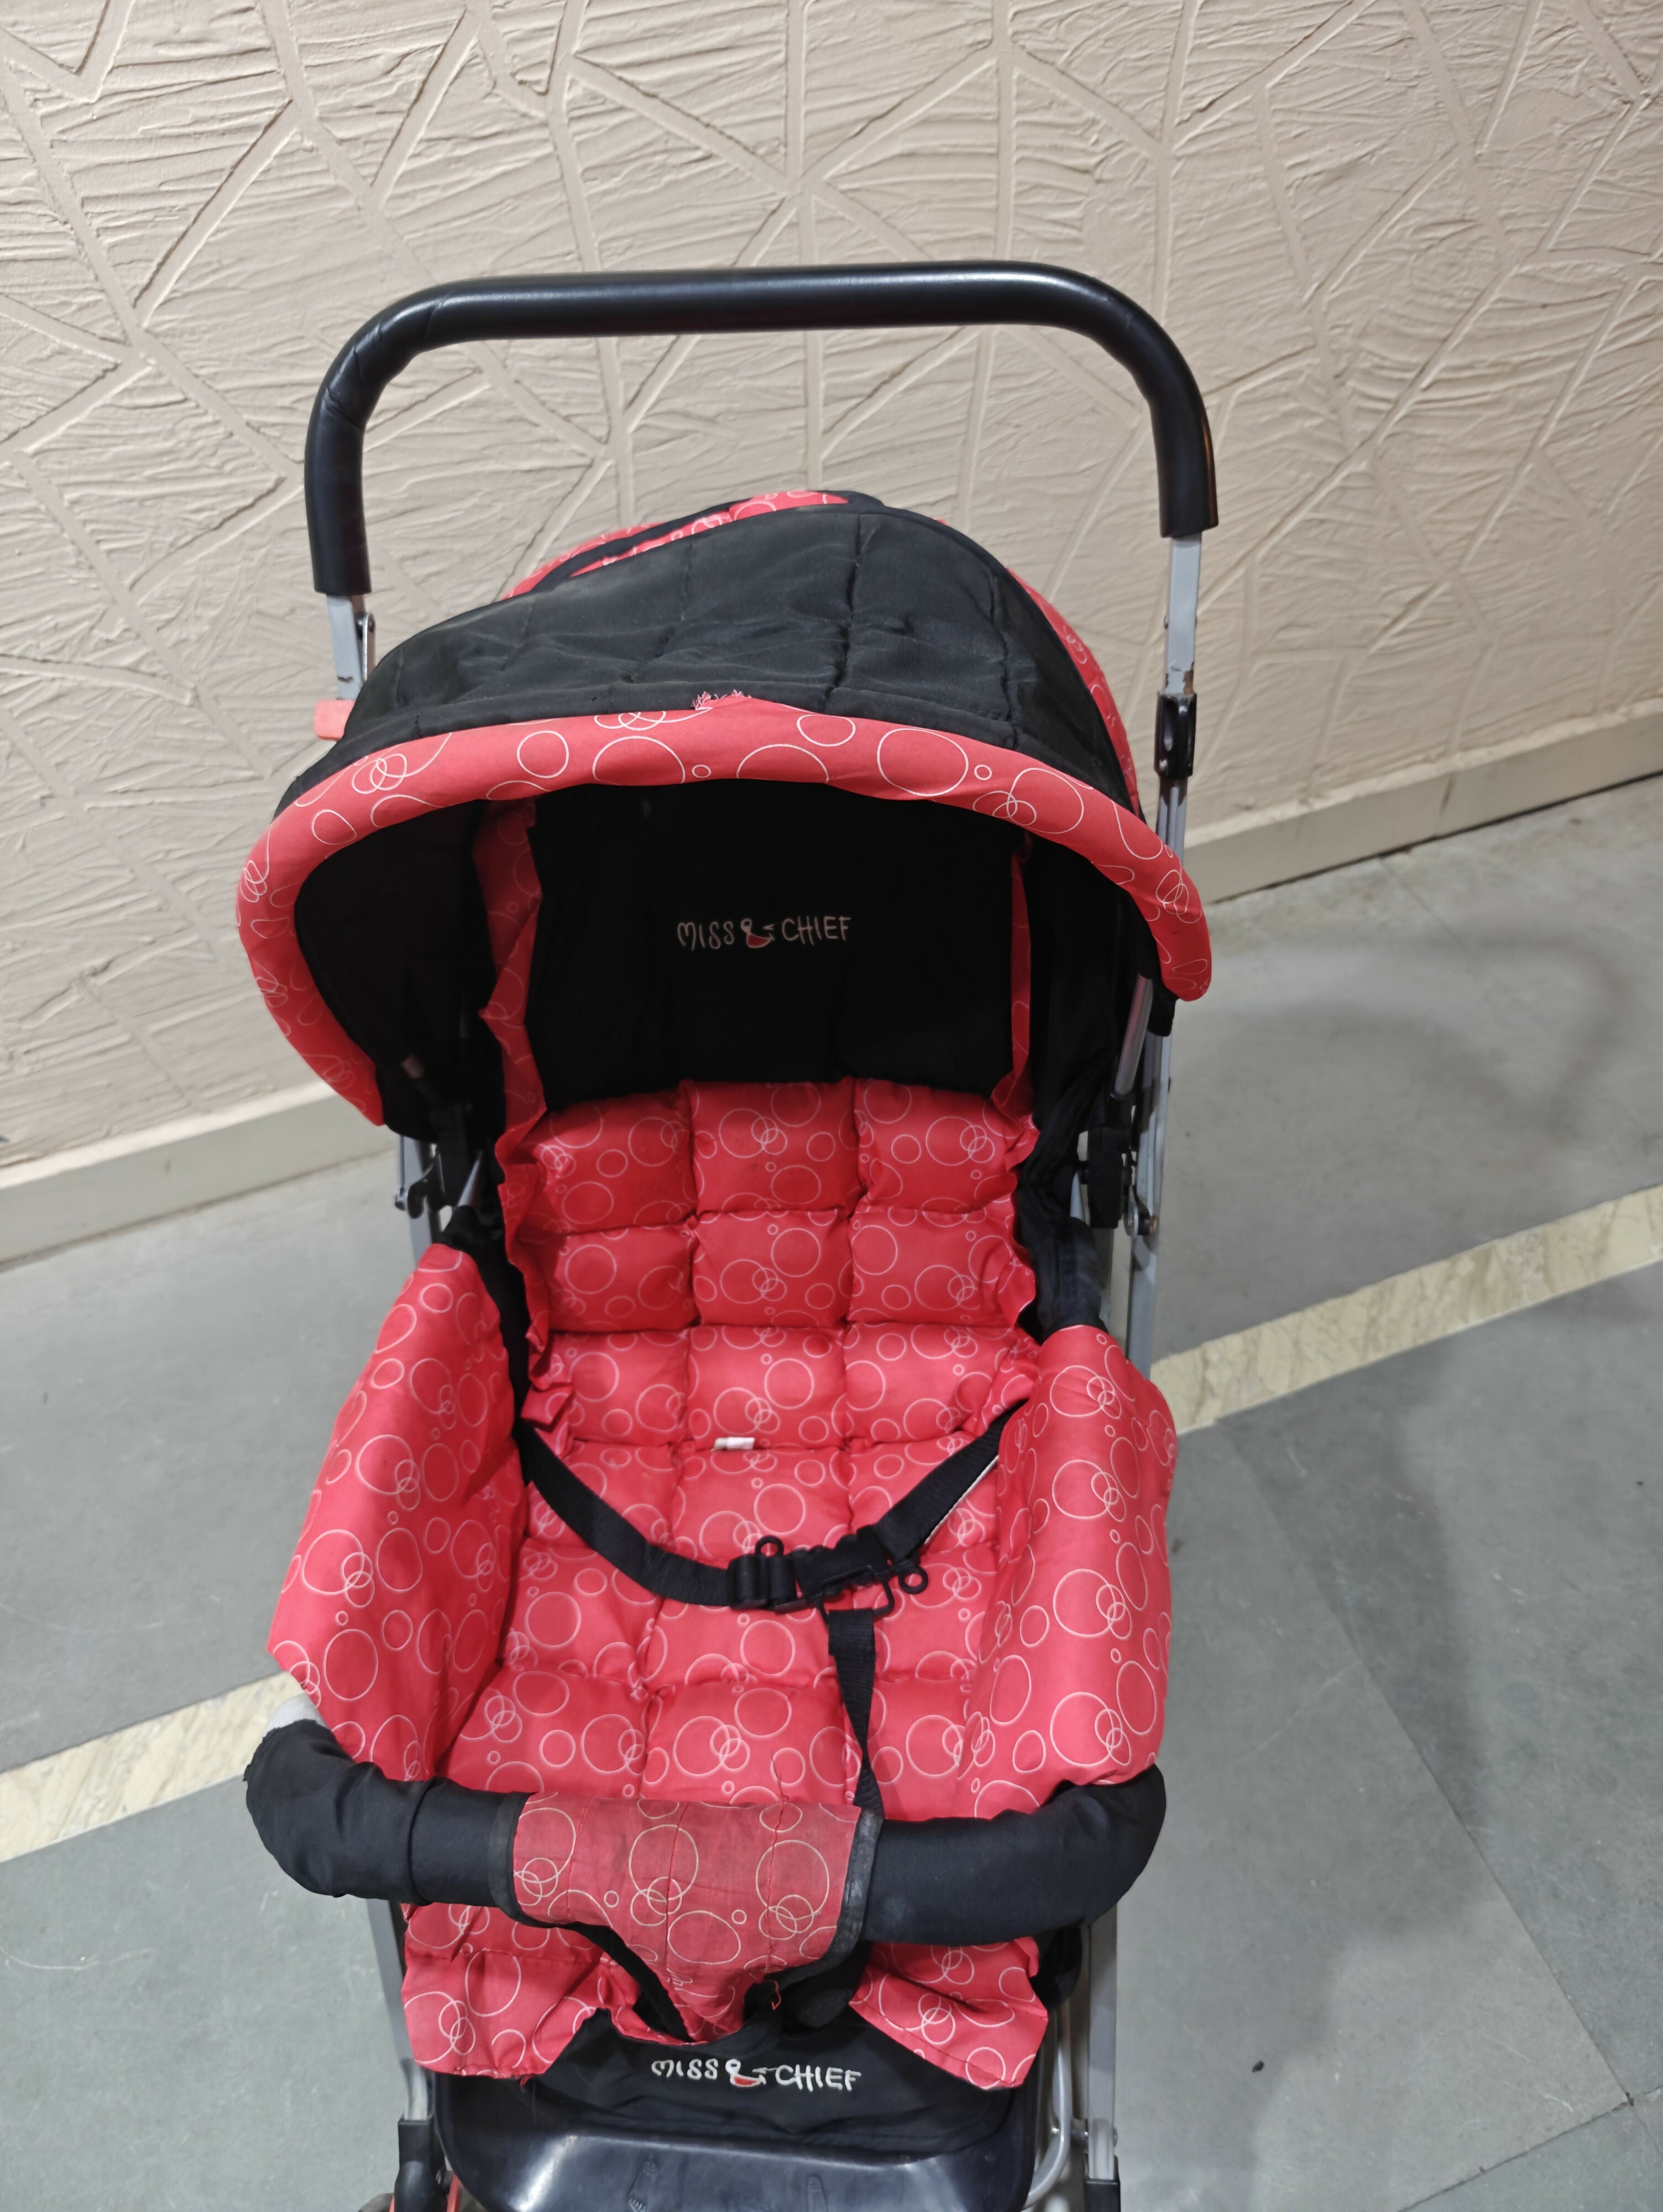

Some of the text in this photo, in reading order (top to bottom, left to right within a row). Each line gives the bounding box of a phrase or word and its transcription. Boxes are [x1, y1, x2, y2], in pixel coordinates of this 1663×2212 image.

[677, 921, 735, 951] MISS
[781, 915, 852, 946] CHIEF
[651, 2058, 719, 2080] MISS
[775, 2064, 862, 2092] CHIEF
